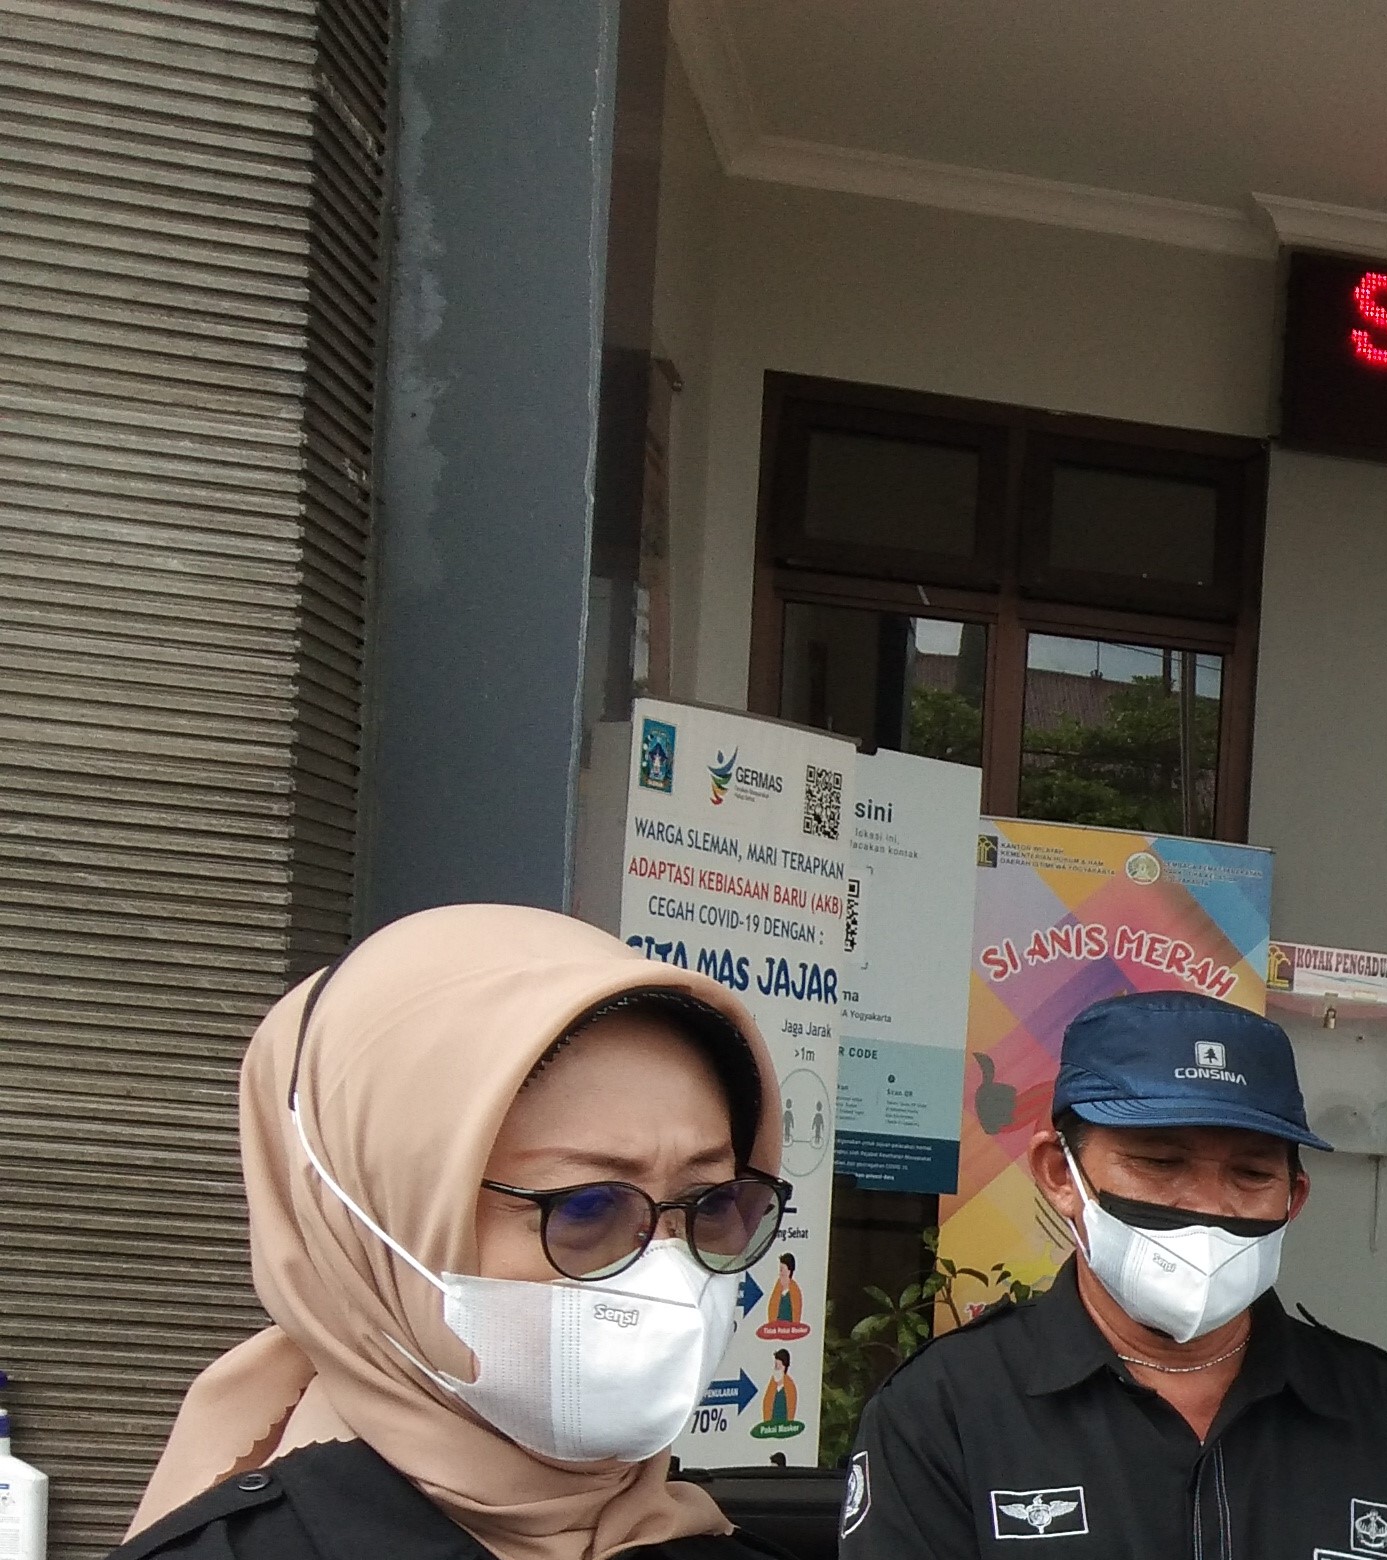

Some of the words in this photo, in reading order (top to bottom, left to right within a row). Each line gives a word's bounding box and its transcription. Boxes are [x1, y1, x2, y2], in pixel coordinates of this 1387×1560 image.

[735, 766, 783, 793] GERMAS
[854, 799, 892, 823] sini
[634, 817, 683, 845] WARGA
[688, 829, 742, 862] SLEMAN,
[746, 842, 777, 866] MARI
[781, 850, 844, 880] TERAPKAN
[628, 855, 694, 886] ADAPTASI
[699, 869, 769, 900] KEBIASAAN
[773, 885, 807, 908] BARU
[811, 892, 843, 919] (AKB)
[648, 895, 694, 921] CEGAH
[700, 905, 759, 932] COVID-19
[764, 916, 815, 943] DENGAN
[981, 938, 1020, 981] SI
[1024, 924, 1109, 965] ANIS
[1114, 926, 1239, 999] MERAH
[1296, 948, 1333, 971] KOTAK
[697, 948, 749, 991] MAS
[756, 957, 838, 1004] JAJAR
[782, 1019, 803, 1037] Jaga
[806, 1021, 832, 1038] Jarak
[850, 1010, 892, 1023] Yogyakarta
[848, 1047, 878, 1060] CODE
[1174, 1068, 1247, 1085] CONSINA
[788, 1226, 808, 1239] Sehat
[594, 1304, 639, 1328] Sensi
[691, 1408, 727, 1434] 70%
